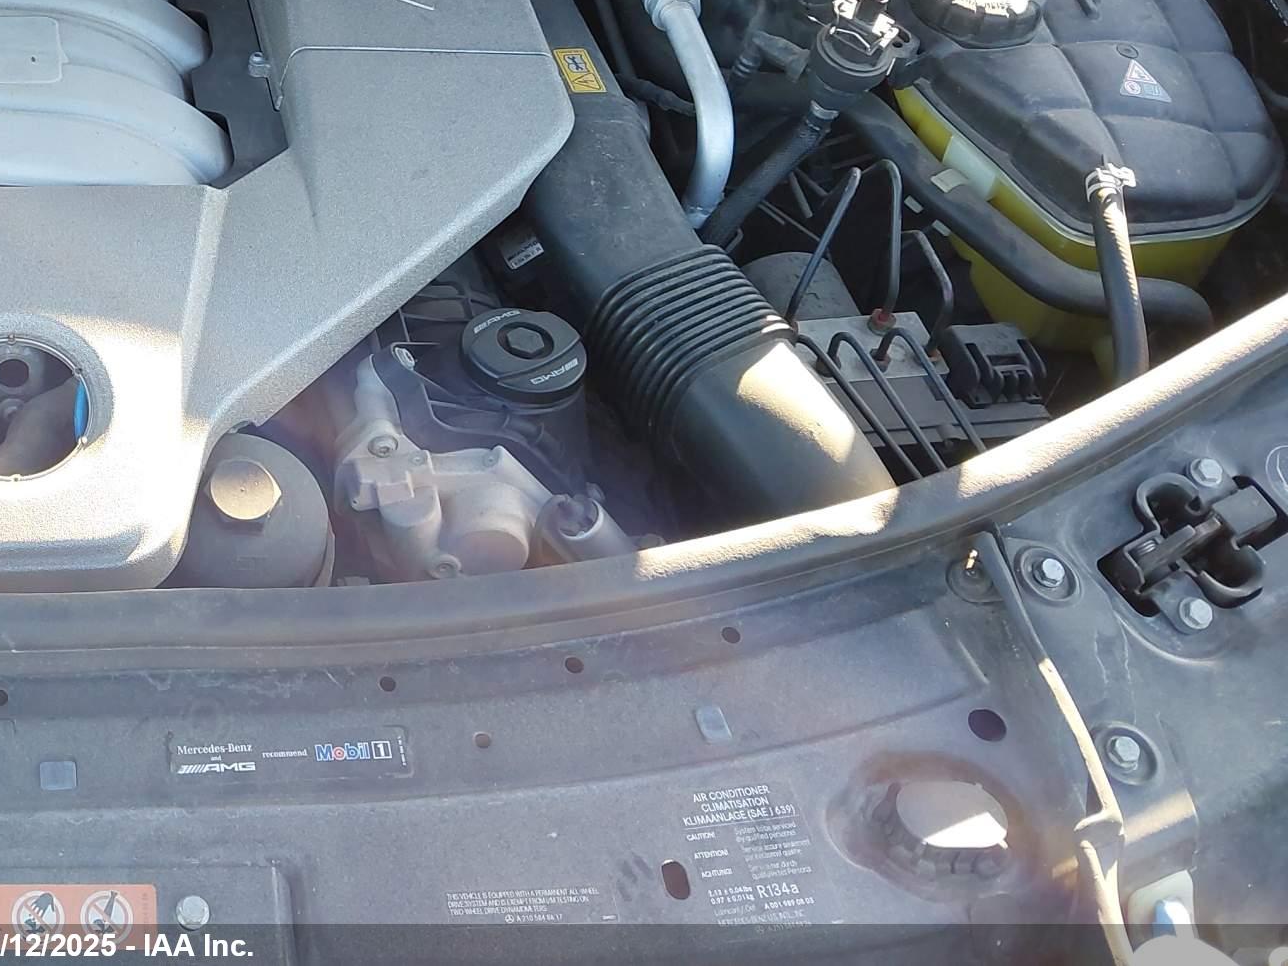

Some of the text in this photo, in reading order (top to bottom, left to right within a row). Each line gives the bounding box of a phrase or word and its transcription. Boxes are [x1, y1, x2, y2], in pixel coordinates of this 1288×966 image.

[177, 743, 253, 755] Mercedes-Benz
[262, 749, 308, 759] recommend
[314, 742, 370, 761] Mobil
[693, 785, 771, 803] AIR CONDITIONER
[701, 796, 770, 813] CLIMATISATION
[682, 811, 747, 827] KLIMAANLAGE
[747, 808, 768, 820] (SAE
[775, 804, 796, 816] 639)
[756, 882, 800, 899] R134a
